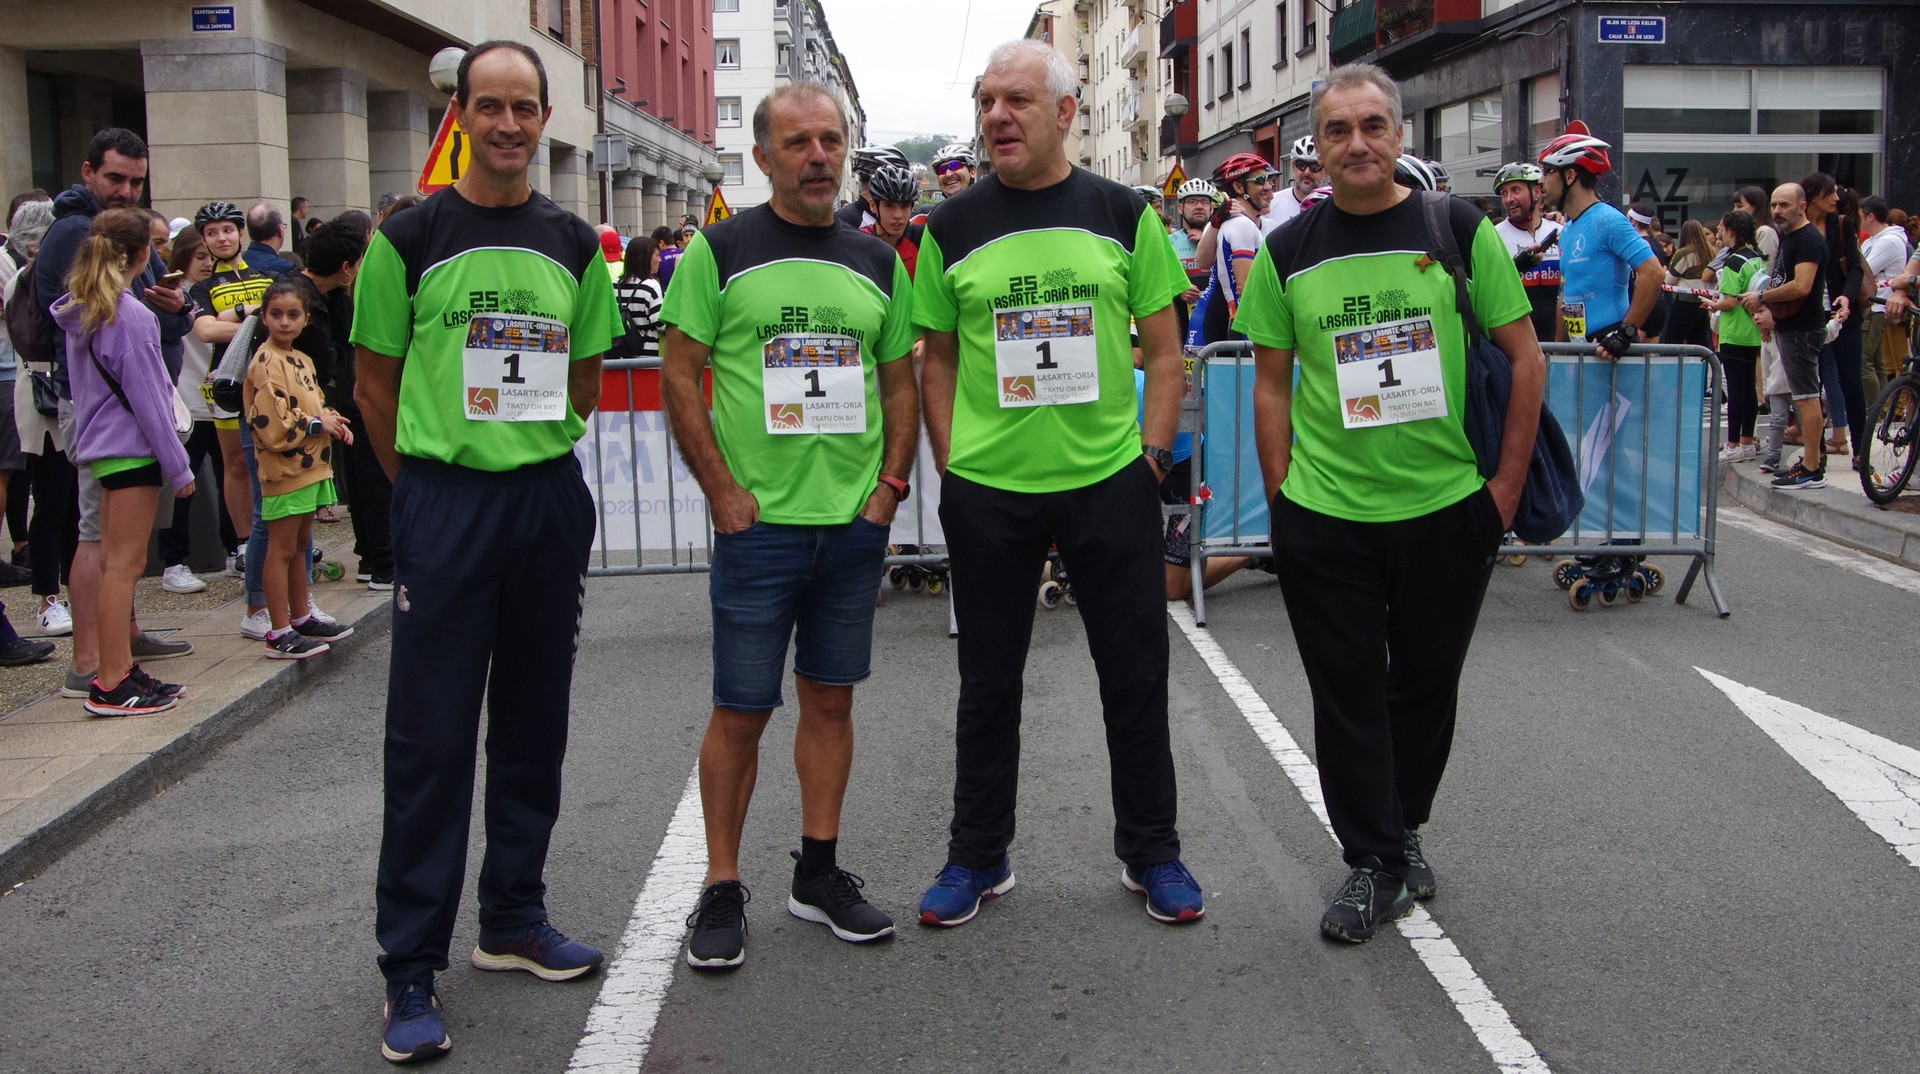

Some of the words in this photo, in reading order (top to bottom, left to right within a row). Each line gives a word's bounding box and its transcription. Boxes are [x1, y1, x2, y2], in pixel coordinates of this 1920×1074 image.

[1632, 168, 1690, 202] AZ
[1009, 275, 1037, 293] 25
[469, 291, 499, 308] 25
[1343, 295, 1371, 312] 25
[781, 306, 808, 322] 25
[1036, 341, 1058, 370] 1
[502, 354, 525, 384] 1
[1037, 372, 1095, 382] LASARTE-ORIA
[1378, 358, 1401, 388] 1
[804, 370, 826, 398] 1
[502, 388, 564, 398] LASARTE-ORIA
[1381, 386, 1441, 400] LASARTE-ORIA
[1388, 402, 1411, 412] TRATU
[1418, 408, 1438, 416] TRATO
